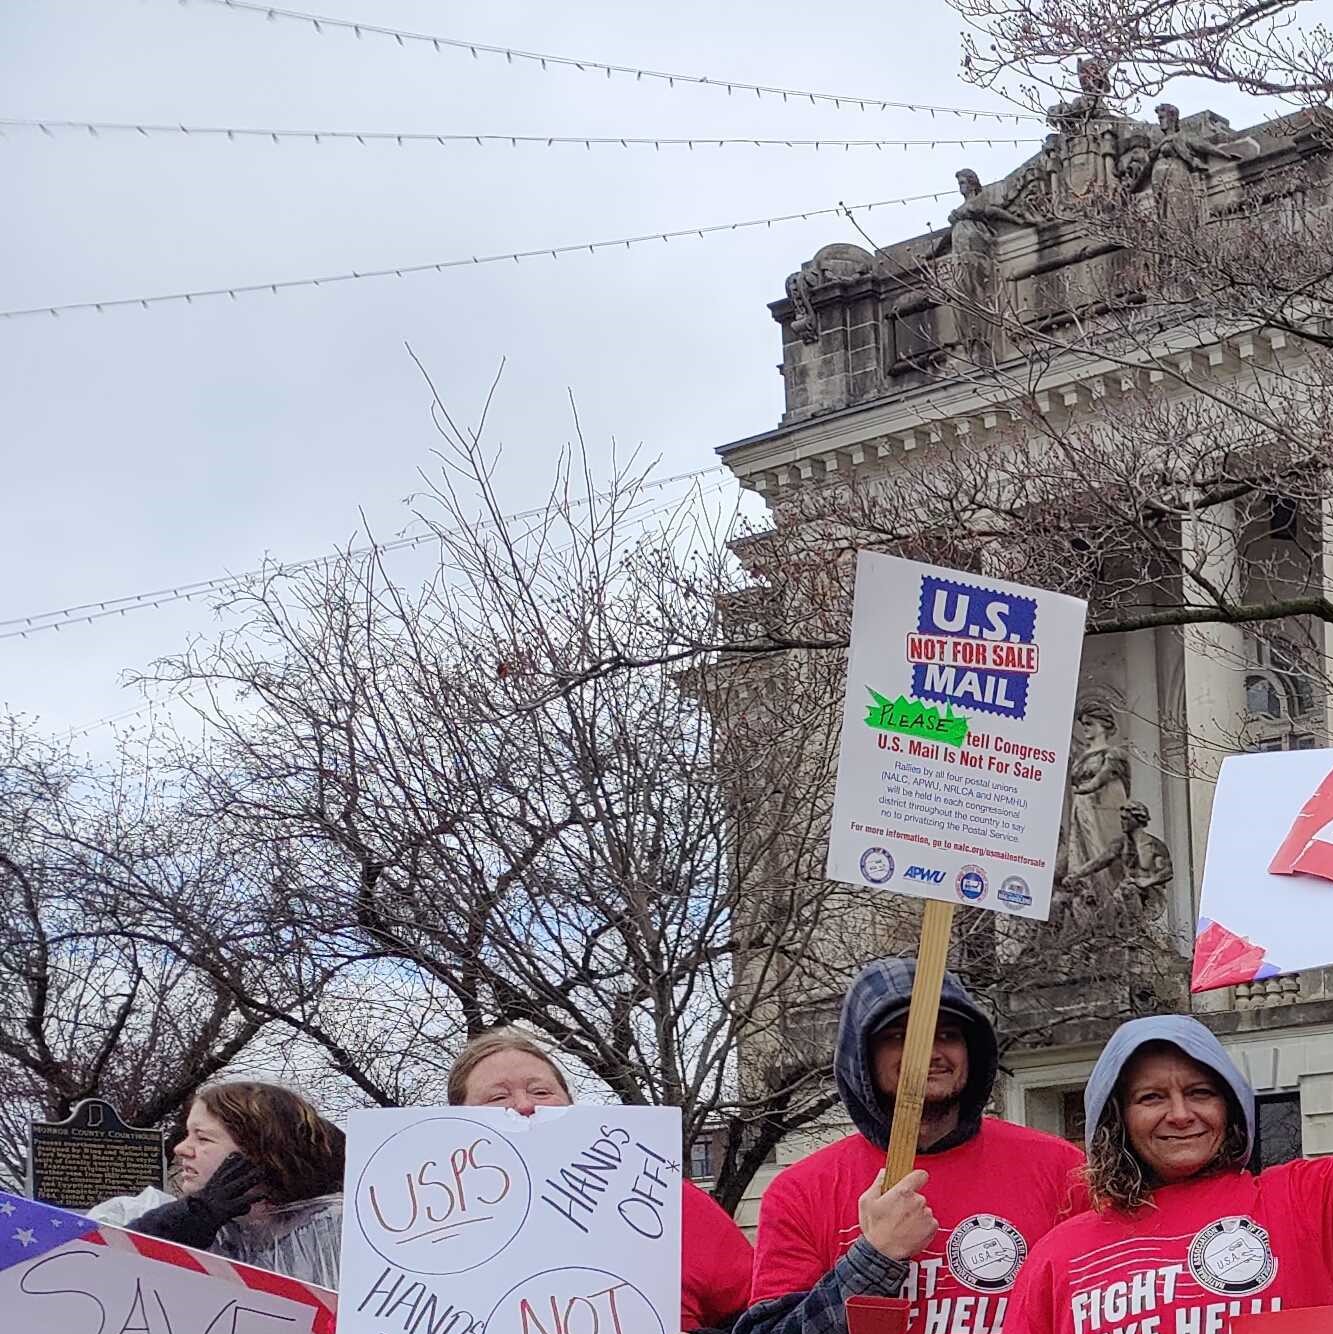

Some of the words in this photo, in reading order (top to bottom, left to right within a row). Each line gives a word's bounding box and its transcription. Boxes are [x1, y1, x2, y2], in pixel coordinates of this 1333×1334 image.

[932, 589, 1021, 642] U.S.
[910, 638, 947, 661] NOT
[952, 641, 987, 665] FOR
[992, 645, 1035, 669] SALE
[923, 664, 1015, 708] MAIL
[880, 704, 954, 733] PLEASE
[877, 733, 903, 753] U.S.
[909, 740, 938, 760] Mail
[943, 748, 956, 763] Is
[960, 751, 982, 769] Not
[988, 757, 1011, 774] For
[1013, 762, 1042, 781] Sale
[967, 731, 989, 749] tell
[994, 736, 1056, 763] Congress
[924, 768, 933, 777] by
[935, 770, 945, 778] all
[947, 772, 963, 782] four
[965, 777, 991, 787] postal
[992, 782, 1018, 793] unions
[943, 783, 974, 797] NRLCA
[976, 791, 991, 800] and
[878, 796, 907, 808] district
[909, 801, 952, 818] throughout
[955, 810, 967, 820] the
[970, 815, 1000, 829] country
[1002, 820, 1010, 828] to
[902, 788, 913, 797] be
[915, 790, 932, 801] held
[934, 794, 941, 802] in
[965, 802, 1020, 818] congressional
[850, 821, 863, 831] For
[865, 825, 884, 835] more
[944, 840, 952, 848] to
[880, 809, 892, 817] no
[894, 811, 902, 819] to
[904, 814, 945, 830] privatizing
[947, 822, 960, 831] the
[962, 824, 987, 836] Postal
[903, 865, 947, 883] APWU
[368, 1138, 511, 1233] USPS
[540, 1127, 632, 1231] HANDS
[617, 1143, 681, 1239] OFF!
